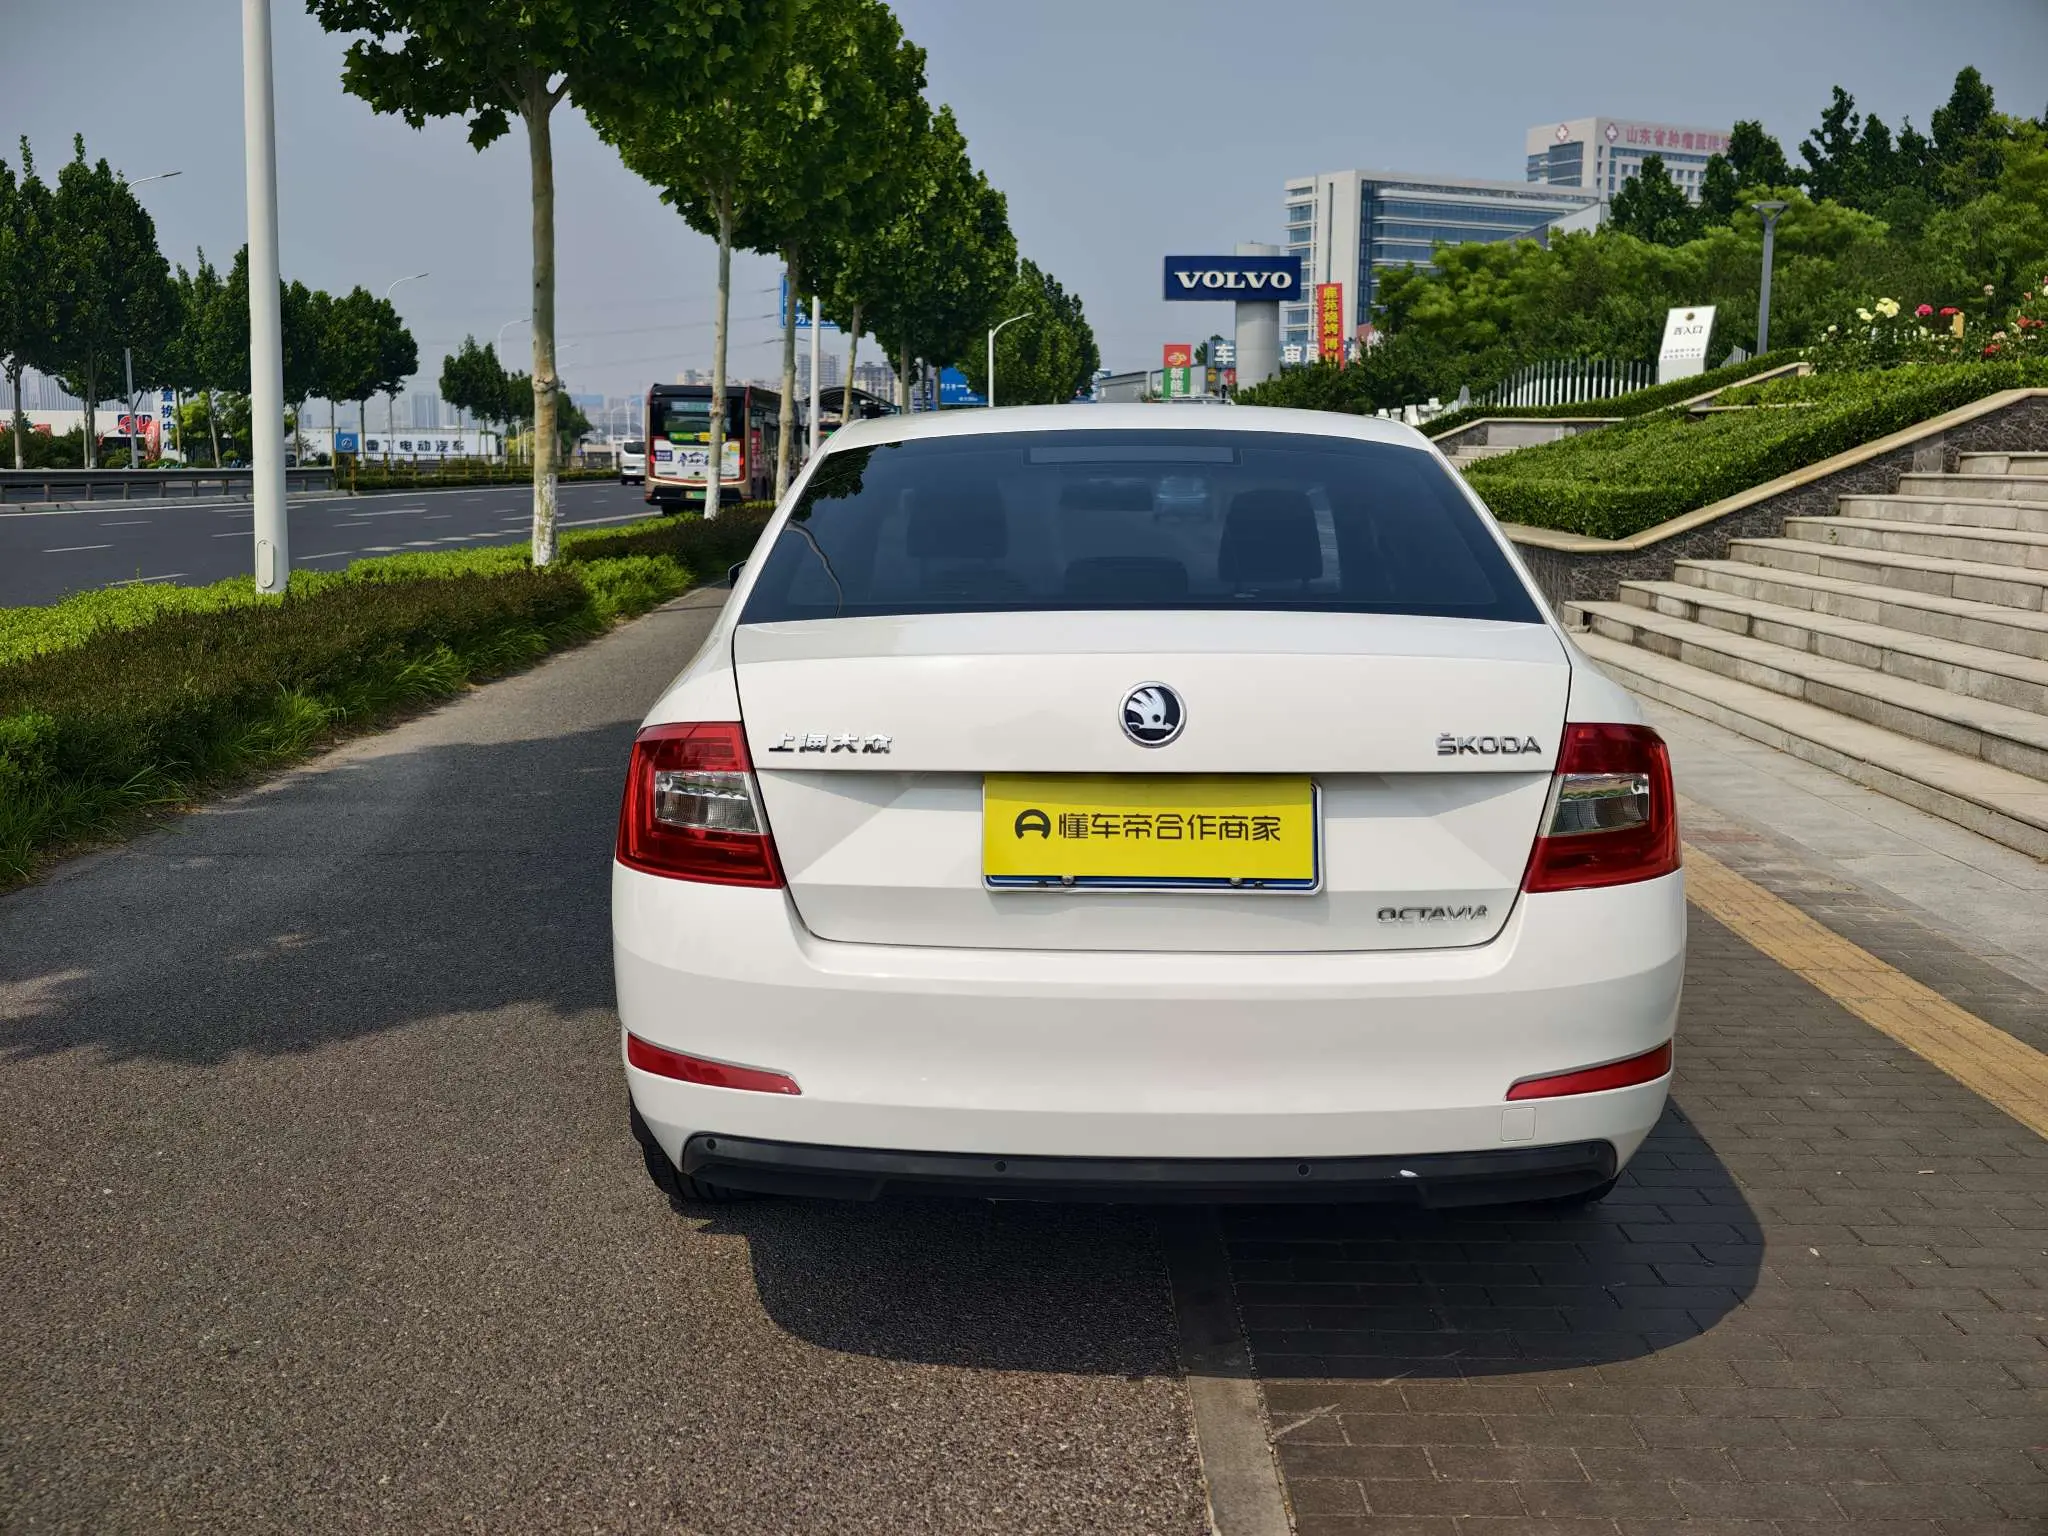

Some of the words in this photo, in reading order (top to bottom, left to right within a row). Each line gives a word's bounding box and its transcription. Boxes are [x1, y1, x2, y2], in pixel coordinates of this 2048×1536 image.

[1174, 270, 1293, 289] VOLVO
[768, 732, 893, 754] 上海大众
[1436, 732, 1543, 756] ŠKODA
[1058, 812, 1282, 842] 懂车帝合作商家
[1377, 904, 1488, 924] OCTAVIA
